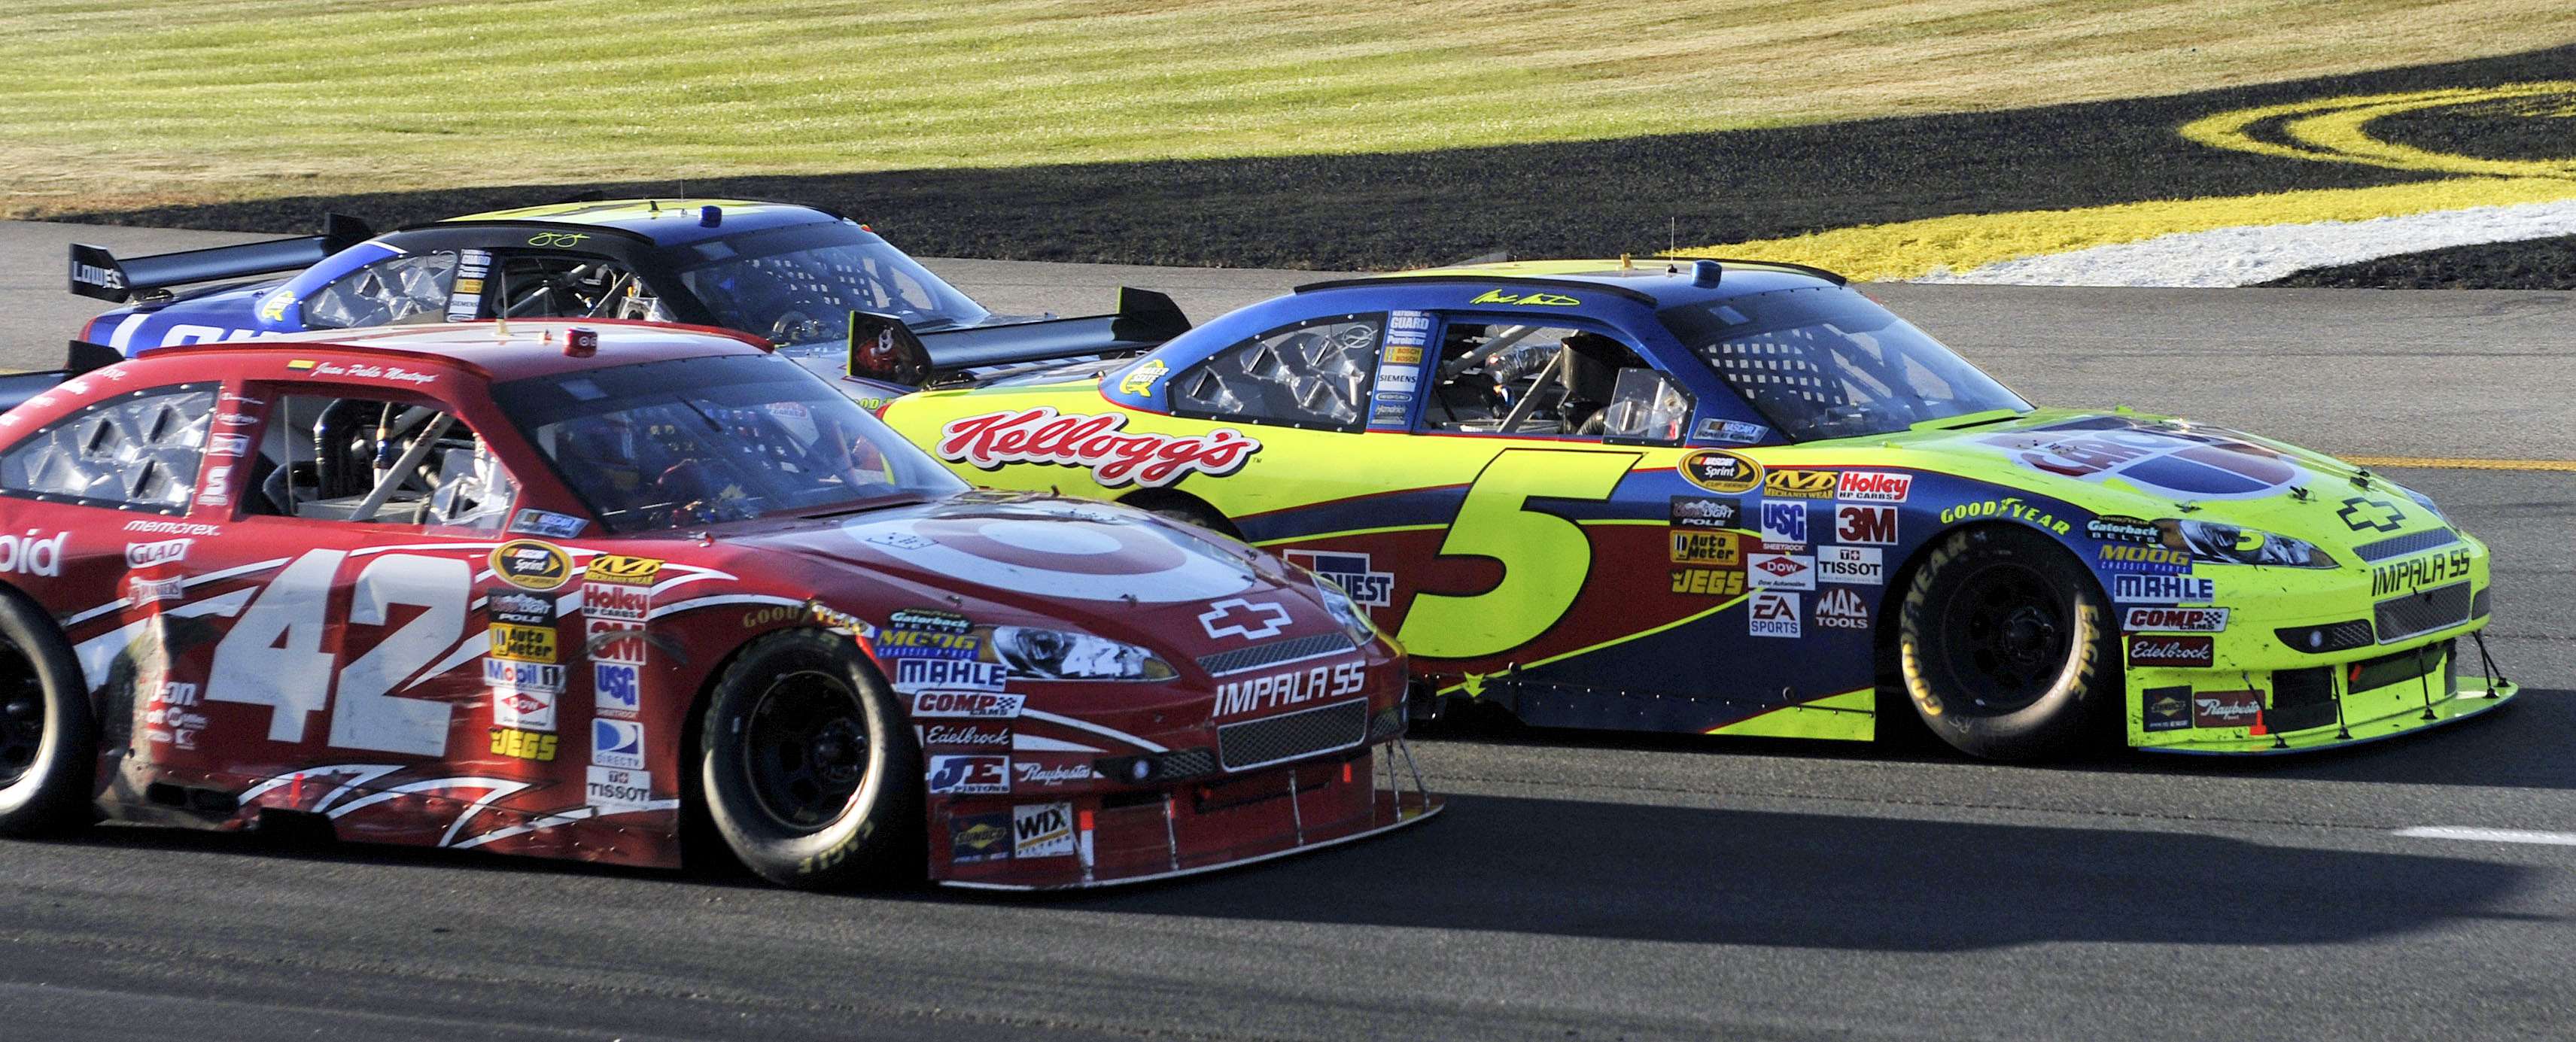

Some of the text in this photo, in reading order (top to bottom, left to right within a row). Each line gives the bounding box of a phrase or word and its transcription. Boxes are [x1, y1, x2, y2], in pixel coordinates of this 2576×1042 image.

[1391, 317, 1429, 330] GUARD
[311, 361, 344, 377] Juan
[345, 363, 382, 378] Pablo
[1379, 375, 1416, 383] SIEMENS
[1722, 422, 1756, 433] NASCAR
[942, 408, 1258, 487] Kellogg's
[1702, 457, 1736, 466] NASCAR
[1705, 466, 1735, 478] Sprint
[1764, 487, 1834, 500] MECHANIX WEAR
[1840, 472, 1909, 500] Holley
[1703, 507, 1735, 518] LIGHT
[1682, 518, 1726, 527] POLE
[1763, 503, 1805, 542] USG
[1838, 506, 1896, 543] 3M
[2087, 520, 2159, 536] Gatorback
[1690, 535, 1727, 547] Auto
[1762, 543, 1804, 551] SHEETROCK
[2092, 532, 2156, 543] BELTS
[129, 542, 184, 564] GLAD
[1396, 448, 1645, 659] 5
[1687, 547, 1735, 560] Meter
[2099, 545, 2191, 566] MOOG
[513, 558, 546, 572] Sprint
[1819, 561, 1882, 576] TISSOT
[2101, 561, 2188, 574] CHASSIS PARTS
[2371, 552, 2447, 597] IMPALA
[1672, 570, 1745, 595] JEGS
[2115, 576, 2213, 599] MAHLE
[582, 585, 649, 618] Holley
[1752, 595, 1796, 621] EA
[1815, 588, 1869, 617] MAC
[497, 612, 543, 624] POLE
[600, 608, 637, 618] CARBS
[890, 612, 970, 629] Gatorback
[2130, 609, 2204, 627] COMP
[895, 622, 966, 633] BELTS
[1751, 620, 1799, 634] SPORTS
[1815, 617, 1869, 630] TOOLS
[2179, 622, 2216, 630] CAMS
[509, 628, 545, 643] Auto
[591, 620, 646, 663] 3M
[205, 548, 471, 758] 42
[2070, 604, 2100, 701] EAGLE
[2131, 640, 2211, 661] Edelbrock
[488, 660, 538, 685] Mobil
[899, 659, 1008, 687] MAHLE
[597, 664, 637, 706] USG
[1212, 666, 1329, 718] IMPALA
[917, 693, 998, 712] COMP
[490, 728, 559, 761] JEGS
[927, 725, 1010, 746] Edelbrock
[932, 756, 1006, 790] JE
[588, 782, 649, 802] TISSOT
[1016, 808, 1067, 840] WIX
[1017, 834, 1071, 856] FILTERS
